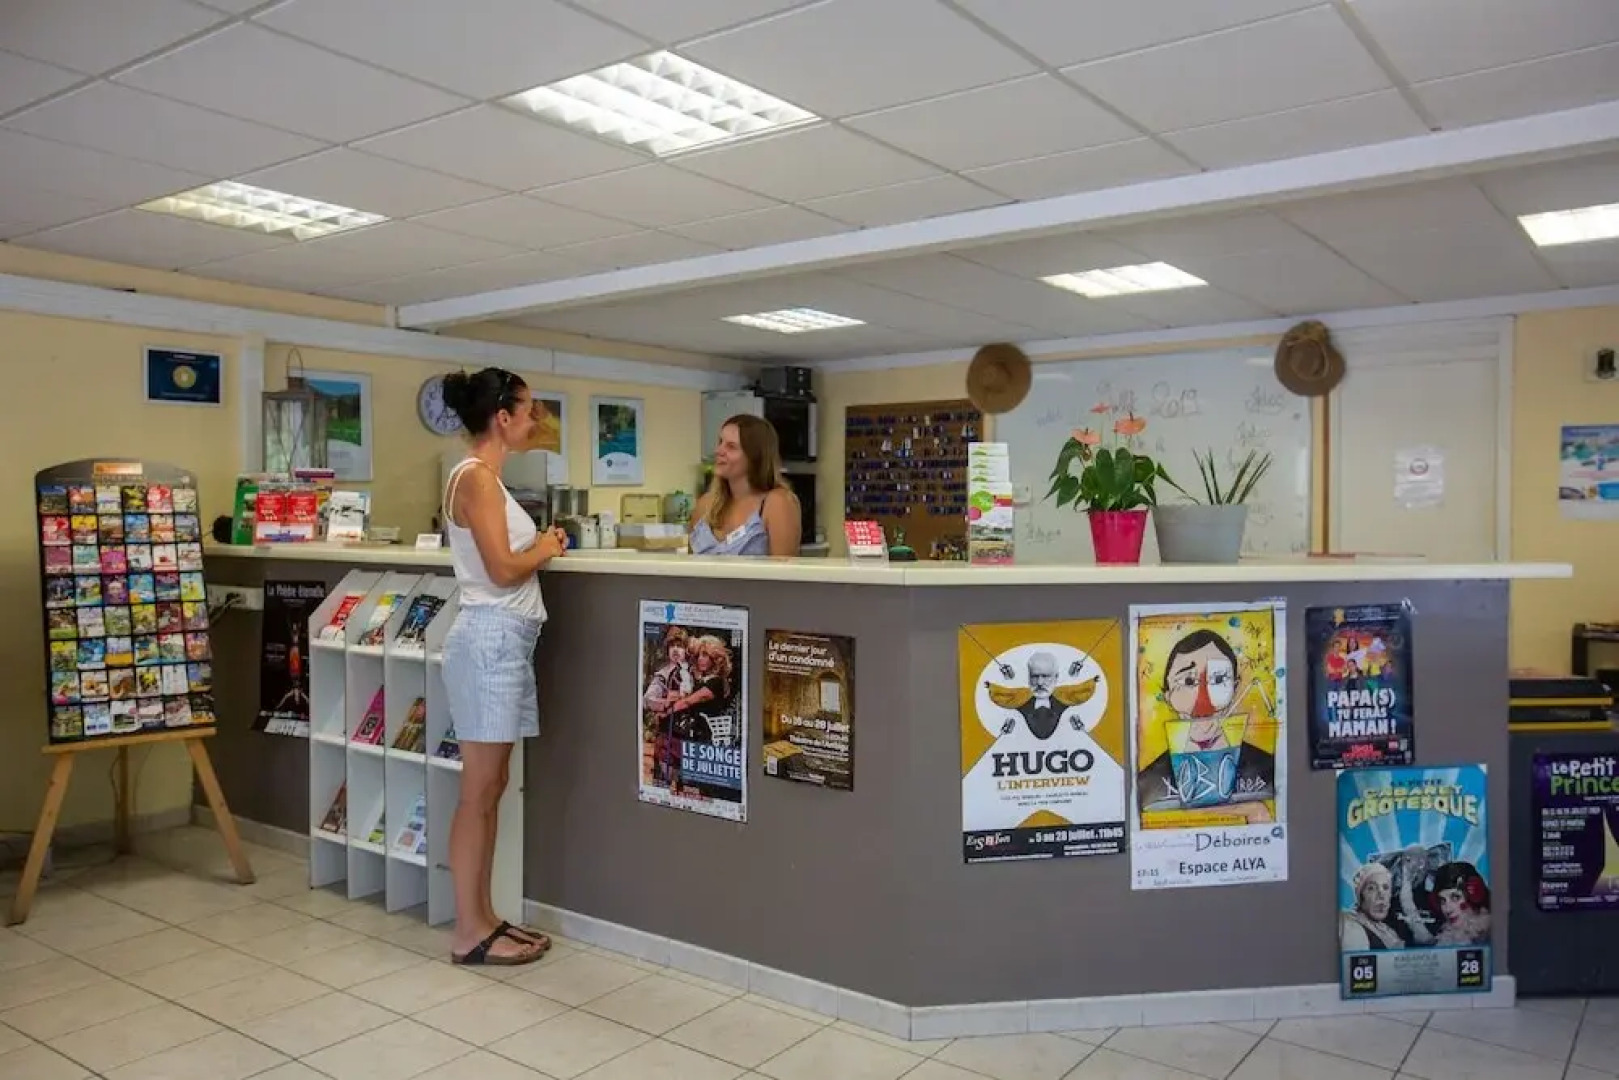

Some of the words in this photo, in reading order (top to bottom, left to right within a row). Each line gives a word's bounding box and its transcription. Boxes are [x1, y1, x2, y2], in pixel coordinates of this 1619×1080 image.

[768, 639, 780, 651] Le
[780, 642, 811, 654] dernier
[811, 645, 828, 658] jour
[788, 655, 835, 669] condamné
[1327, 687, 1395, 709] PAPA(S)
[1336, 708, 1351, 721] TU
[1353, 705, 1387, 719] FERAS
[681, 740, 696, 757] LE
[698, 743, 741, 766] SONGE
[991, 749, 1095, 777] HUGO
[682, 757, 697, 772] DE
[697, 760, 741, 780] JULIETTE
[1552, 762, 1568, 775] Le
[1569, 757, 1616, 778] Petit
[997, 776, 1090, 791] L'INTERVIEW
[1550, 773, 1619, 796] Prince
[1346, 794, 1479, 829] GROTESQUE
[1055, 831, 1068, 843] 28
[1195, 831, 1271, 852] Déboires
[1179, 860, 1228, 877] Espace
[1232, 857, 1266, 871] ALYA
[1353, 965, 1375, 980] 05
[1461, 960, 1480, 974] 28
